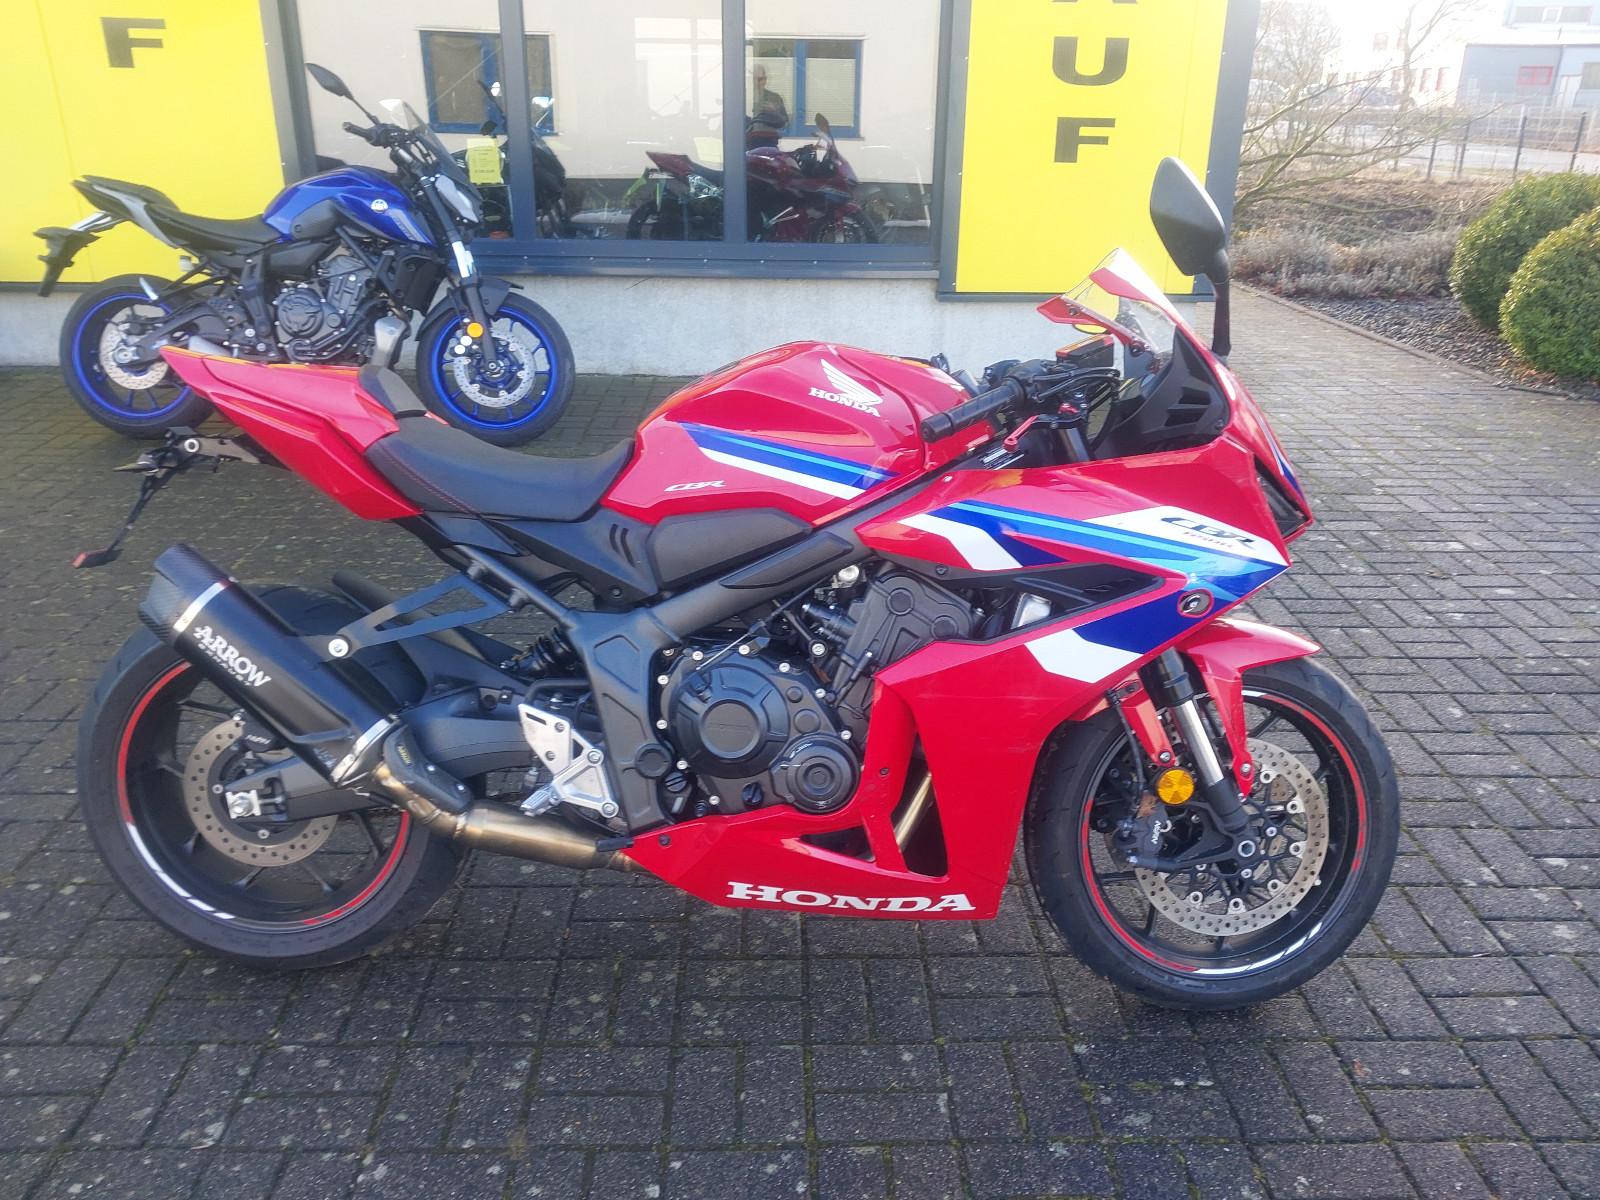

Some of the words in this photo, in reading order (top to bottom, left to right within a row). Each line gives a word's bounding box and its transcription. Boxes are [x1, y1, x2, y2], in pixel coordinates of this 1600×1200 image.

[100, 17, 166, 68] F
[808, 387, 880, 417] HONDA
[664, 480, 727, 492] CBR
[1160, 517, 1256, 550] CBR
[193, 625, 272, 687] ARROW
[726, 881, 976, 912] HONDA
